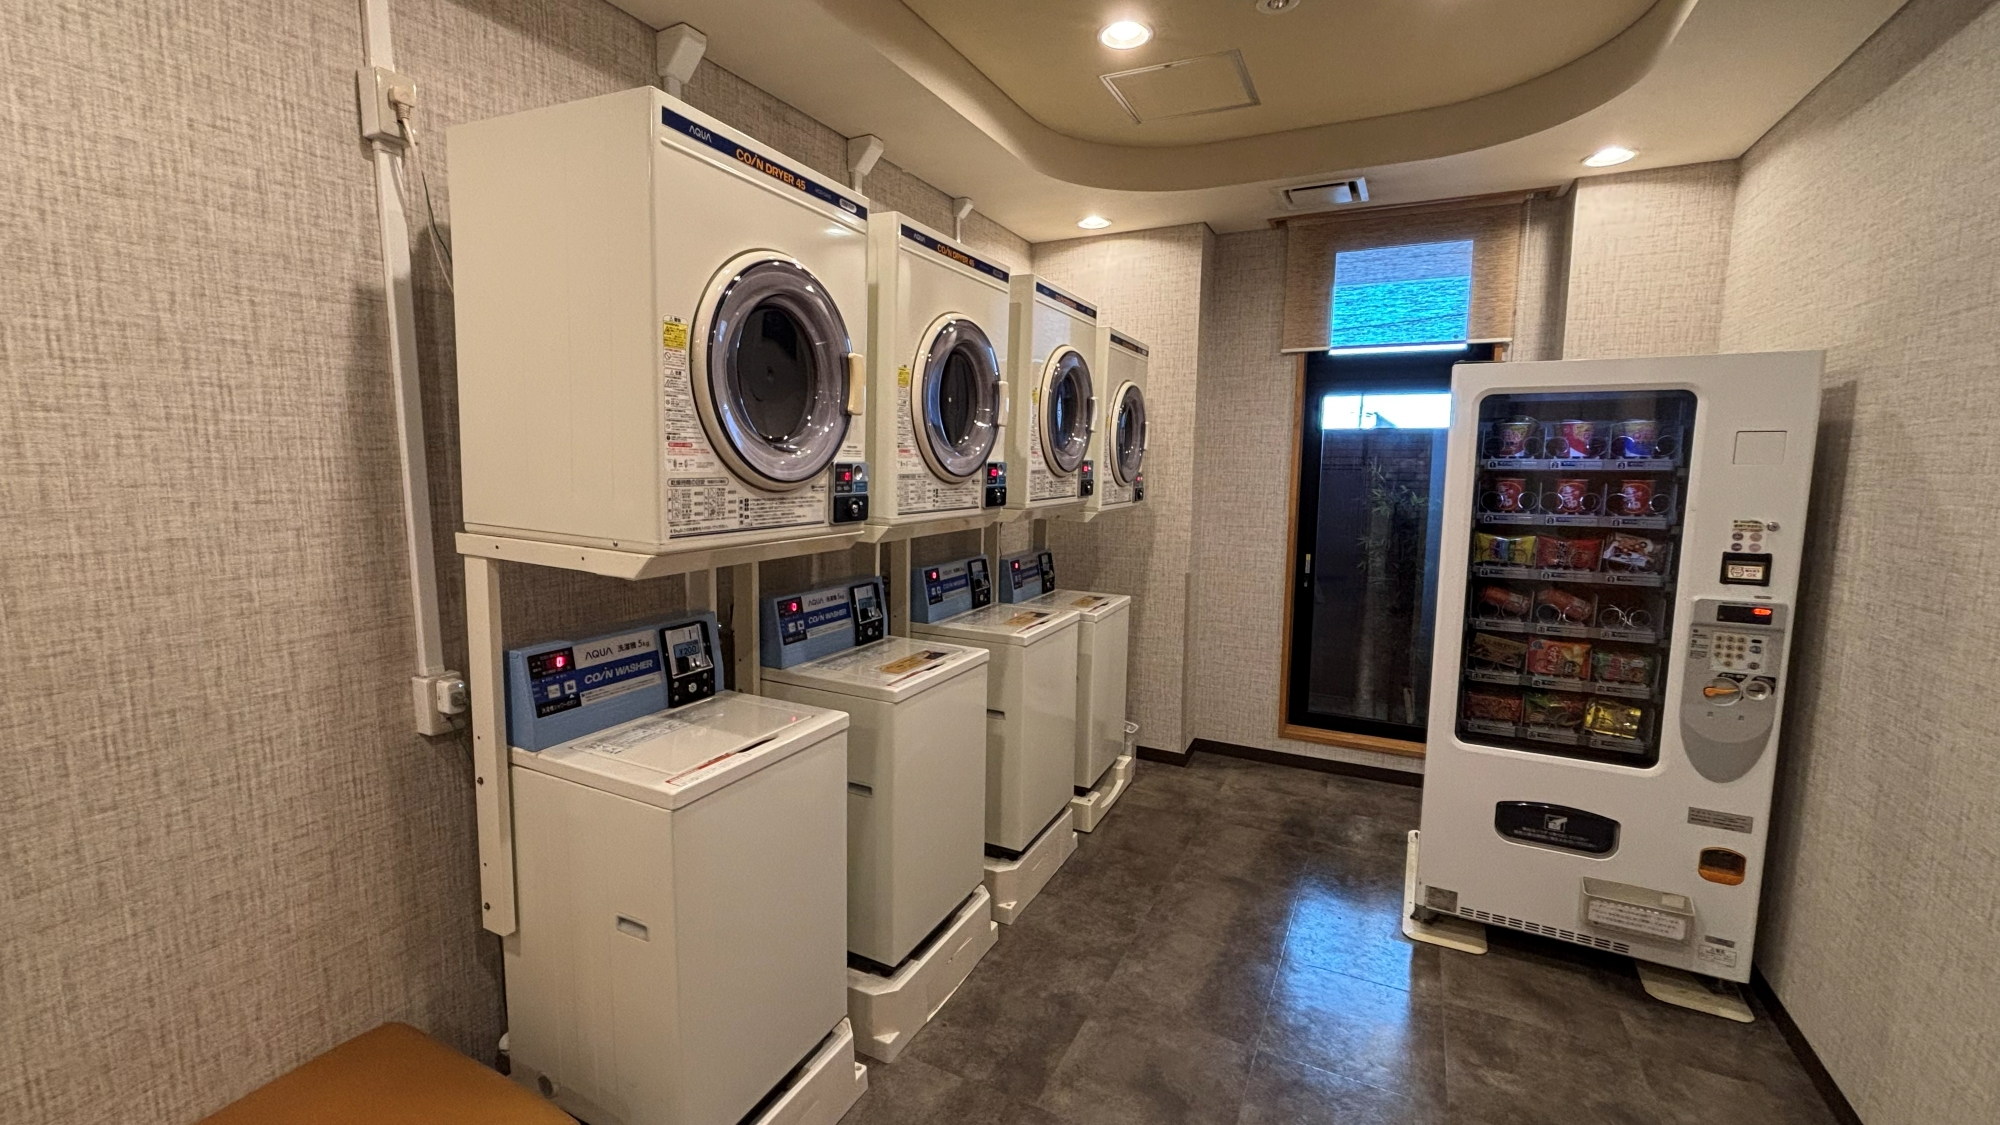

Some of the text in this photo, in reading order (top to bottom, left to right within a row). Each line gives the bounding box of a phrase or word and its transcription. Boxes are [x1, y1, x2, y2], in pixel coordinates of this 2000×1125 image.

[688, 124, 713, 144] AQUA
[765, 162, 795, 186] DRYER
[795, 177, 807, 191] 45
[790, 602, 798, 612] 0
[808, 597, 824, 607] AQUA
[585, 646, 614, 660] AQUA
[637, 639, 650, 649] 5kg
[556, 656, 565, 668] 0
[615, 659, 653, 676] WASHER
